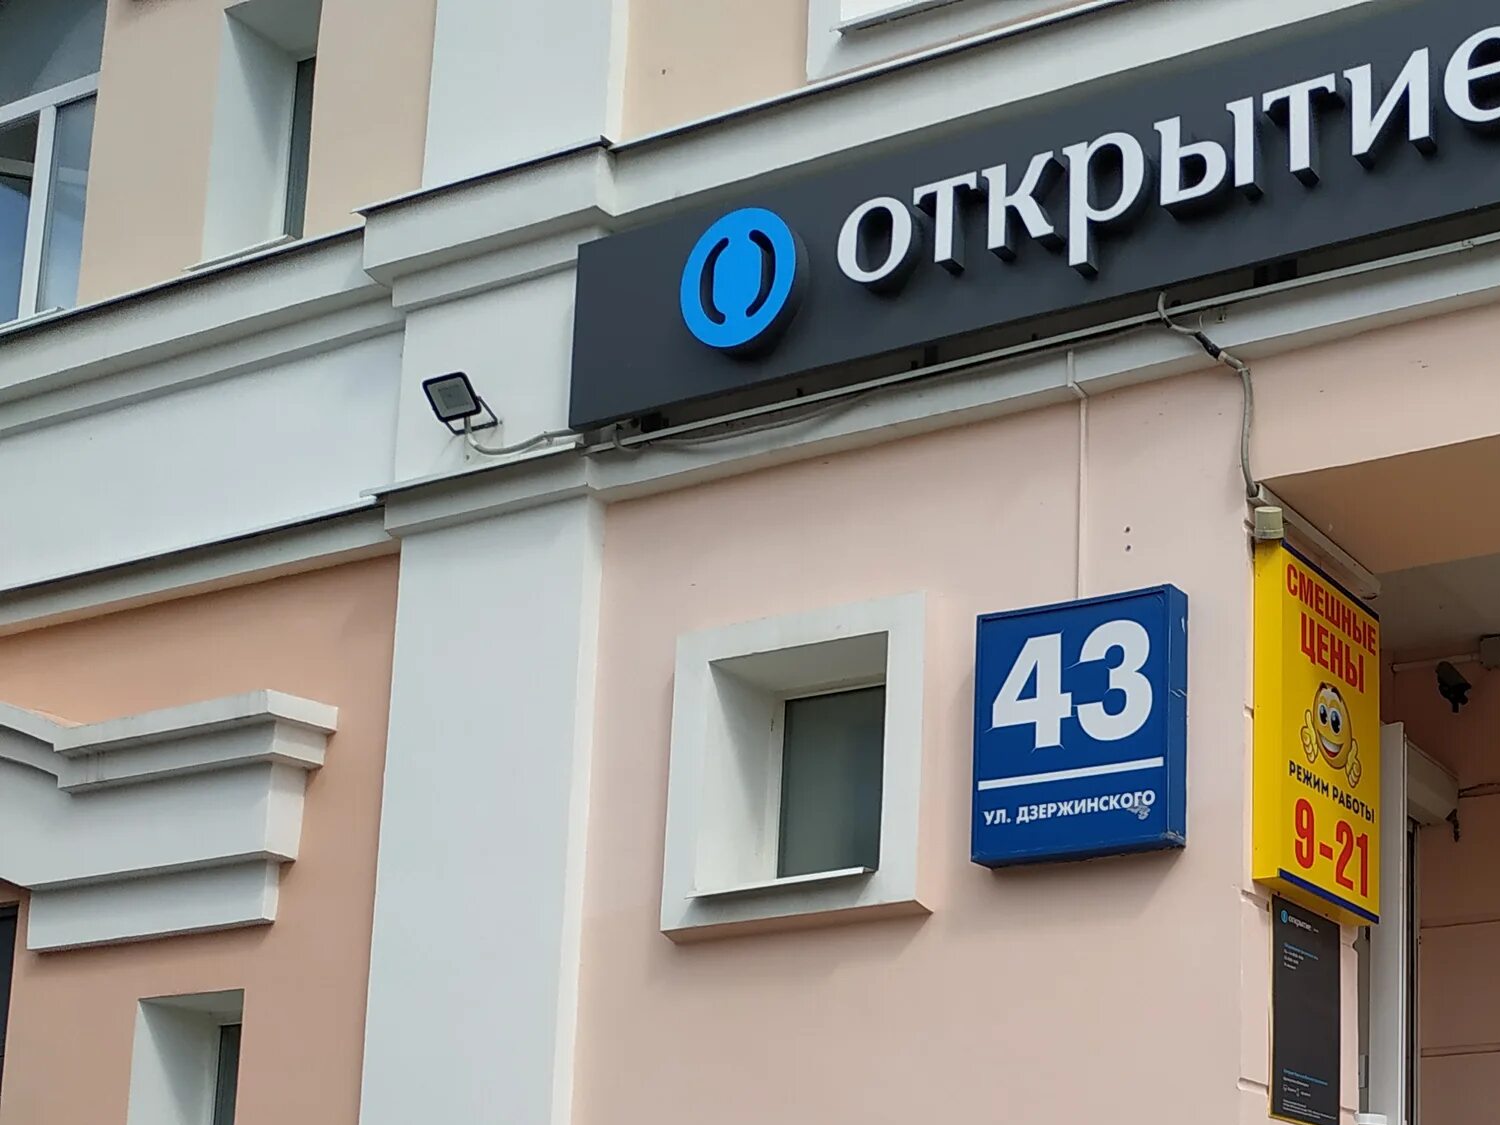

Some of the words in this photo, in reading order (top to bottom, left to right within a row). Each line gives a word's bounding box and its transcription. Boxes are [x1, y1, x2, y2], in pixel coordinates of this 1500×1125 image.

[1287, 563, 1377, 656] СМЕШНЫЕ
[991, 619, 1153, 749] 43
[1300, 612, 1364, 694] ЦЕНЫ
[983, 809, 1012, 826] УЛ.
[1016, 789, 1157, 825] ДЗЕРЖИНСКОГО
[1289, 760, 1329, 798] РЕЖИМ
[1332, 785, 1375, 824] РАБОТЫ
[1294, 798, 1369, 899] 9-21
